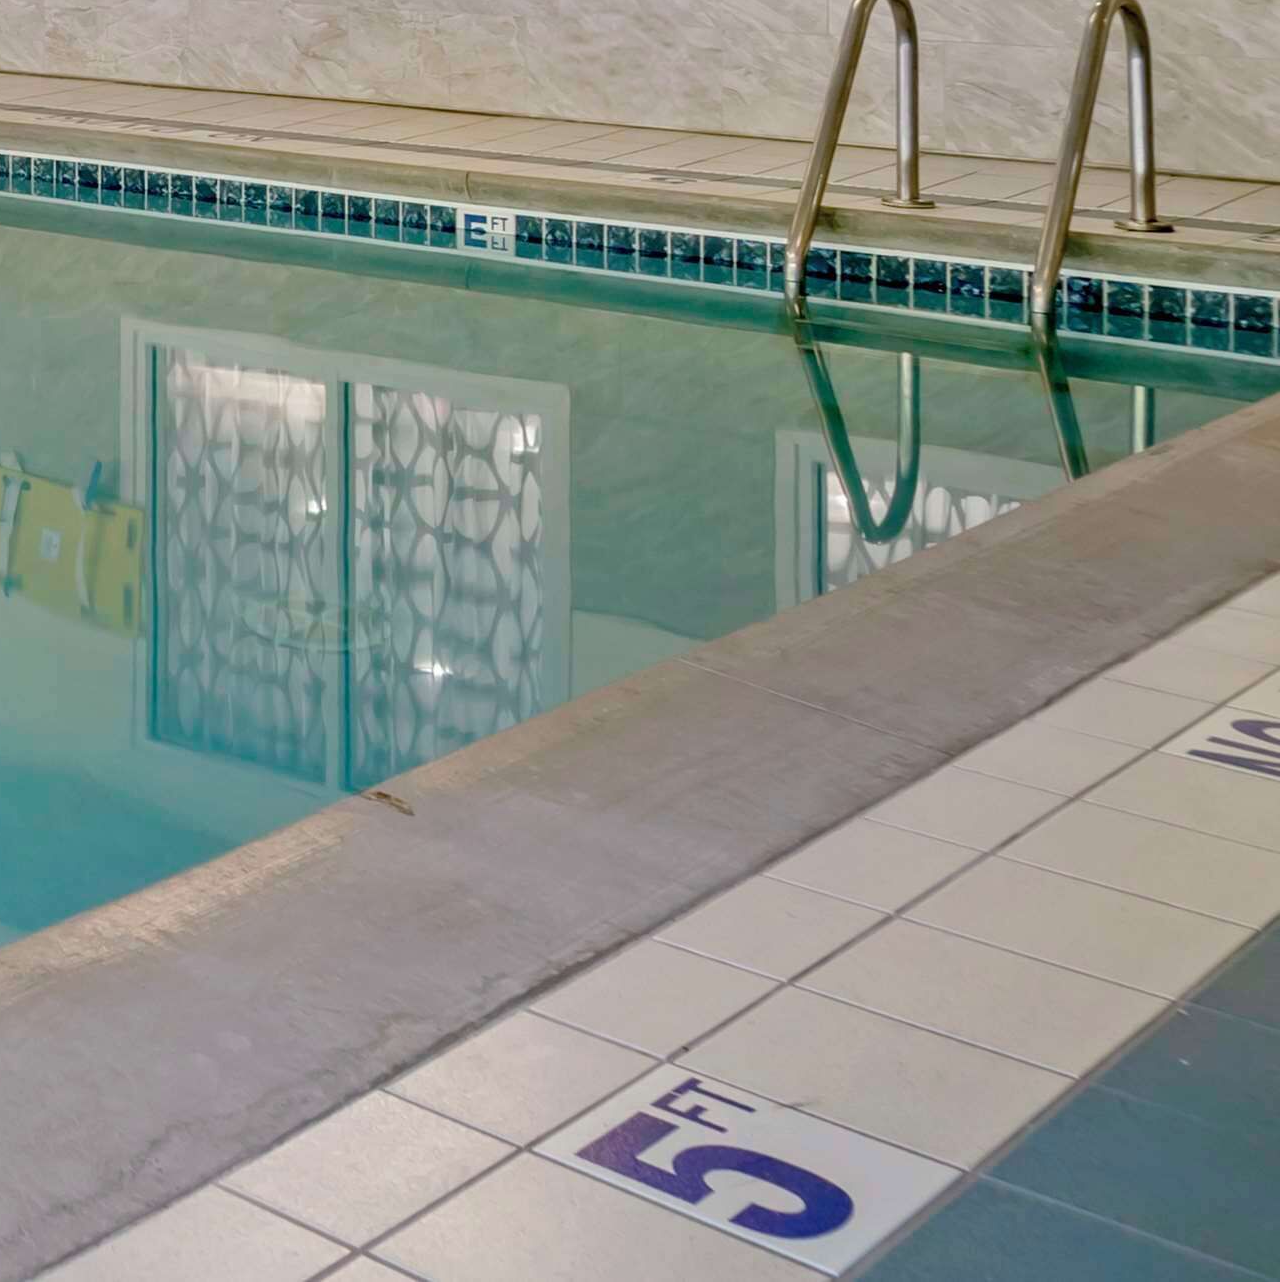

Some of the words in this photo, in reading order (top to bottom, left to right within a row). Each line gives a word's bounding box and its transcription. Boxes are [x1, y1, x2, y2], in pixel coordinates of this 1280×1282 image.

[491, 216, 509, 232] FT
[650, 1077, 757, 1133] FT
[574, 1111, 854, 1241] 5
